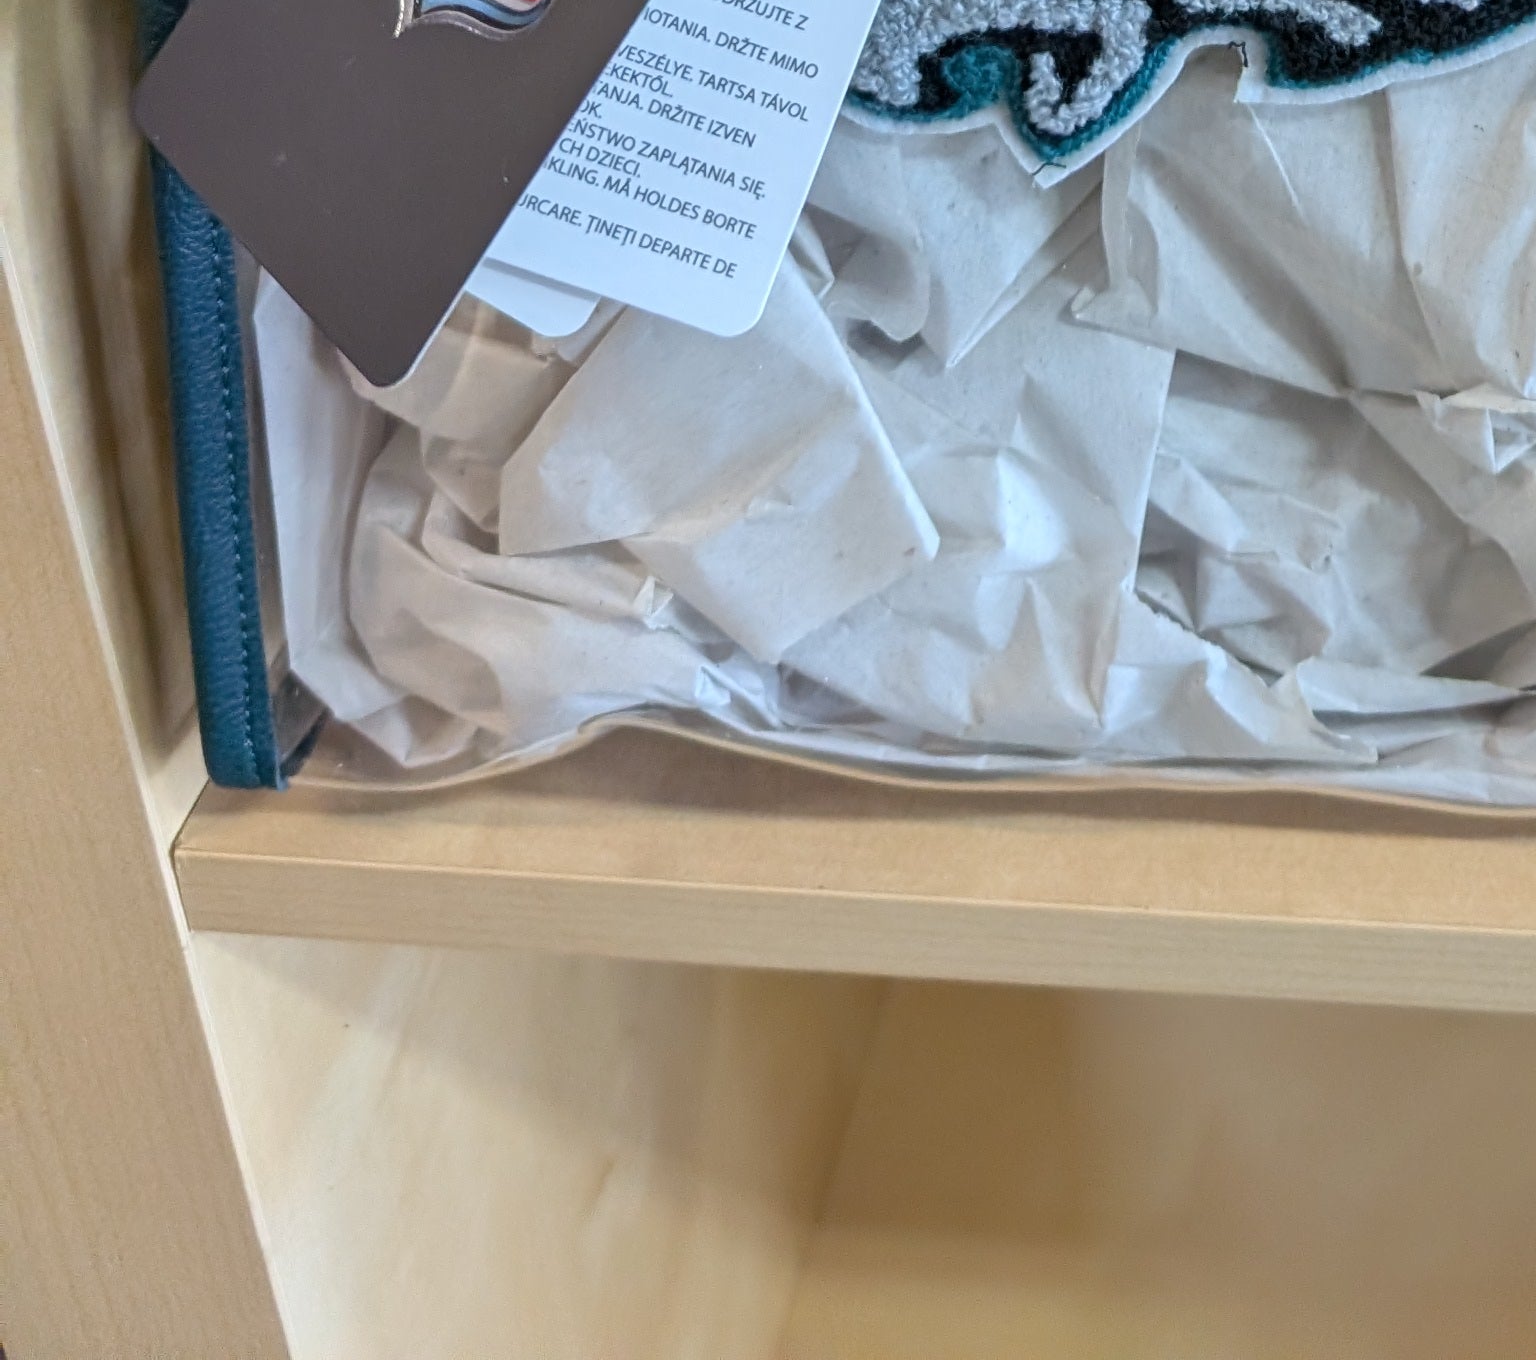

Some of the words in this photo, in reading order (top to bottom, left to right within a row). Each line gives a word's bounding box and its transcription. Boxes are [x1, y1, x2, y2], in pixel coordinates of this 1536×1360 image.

[795, 14, 809, 30] Z
[715, 31, 769, 62] DRŽTE
[769, 51, 819, 79] MIMO
[605, 63, 674, 98] KEKTŐL.
[699, 70, 755, 103] TARTSA
[759, 89, 808, 122] TÁVOL
[594, 80, 643, 110] ANJA.
[648, 99, 707, 131] DRŽITE
[706, 119, 756, 148] IZVEN
[559, 137, 584, 157] CH
[585, 146, 641, 178] DZIECI.
[568, 118, 636, 152] ŃSTWO
[637, 140, 736, 187] ZAPLĄTANIA
[739, 176, 766, 200] SIĘ.
[544, 156, 599, 187] KLING.
[603, 175, 632, 197] MÅ
[633, 187, 701, 220] HOLDES
[702, 209, 758, 240] BORTE
[638, 233, 712, 270] DEPARTE
[713, 257, 738, 278] DE
